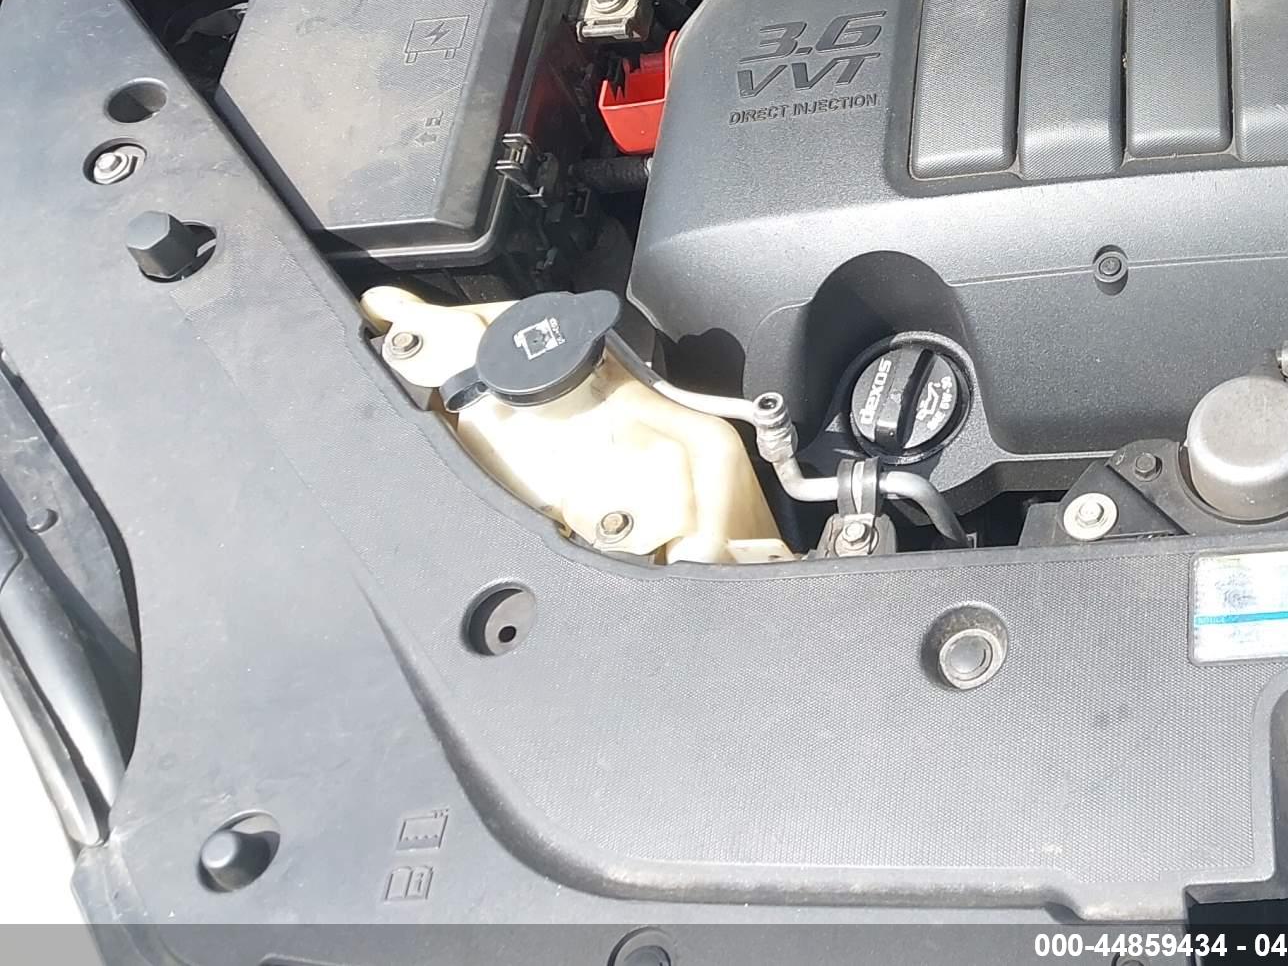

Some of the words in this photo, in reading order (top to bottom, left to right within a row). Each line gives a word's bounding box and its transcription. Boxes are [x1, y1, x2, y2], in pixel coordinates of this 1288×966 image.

[739, 10, 887, 65] 3.6
[737, 52, 881, 98] VVT
[728, 104, 790, 126] DIRECT
[793, 93, 878, 116] INJECTION
[859, 357, 893, 425] dexos
